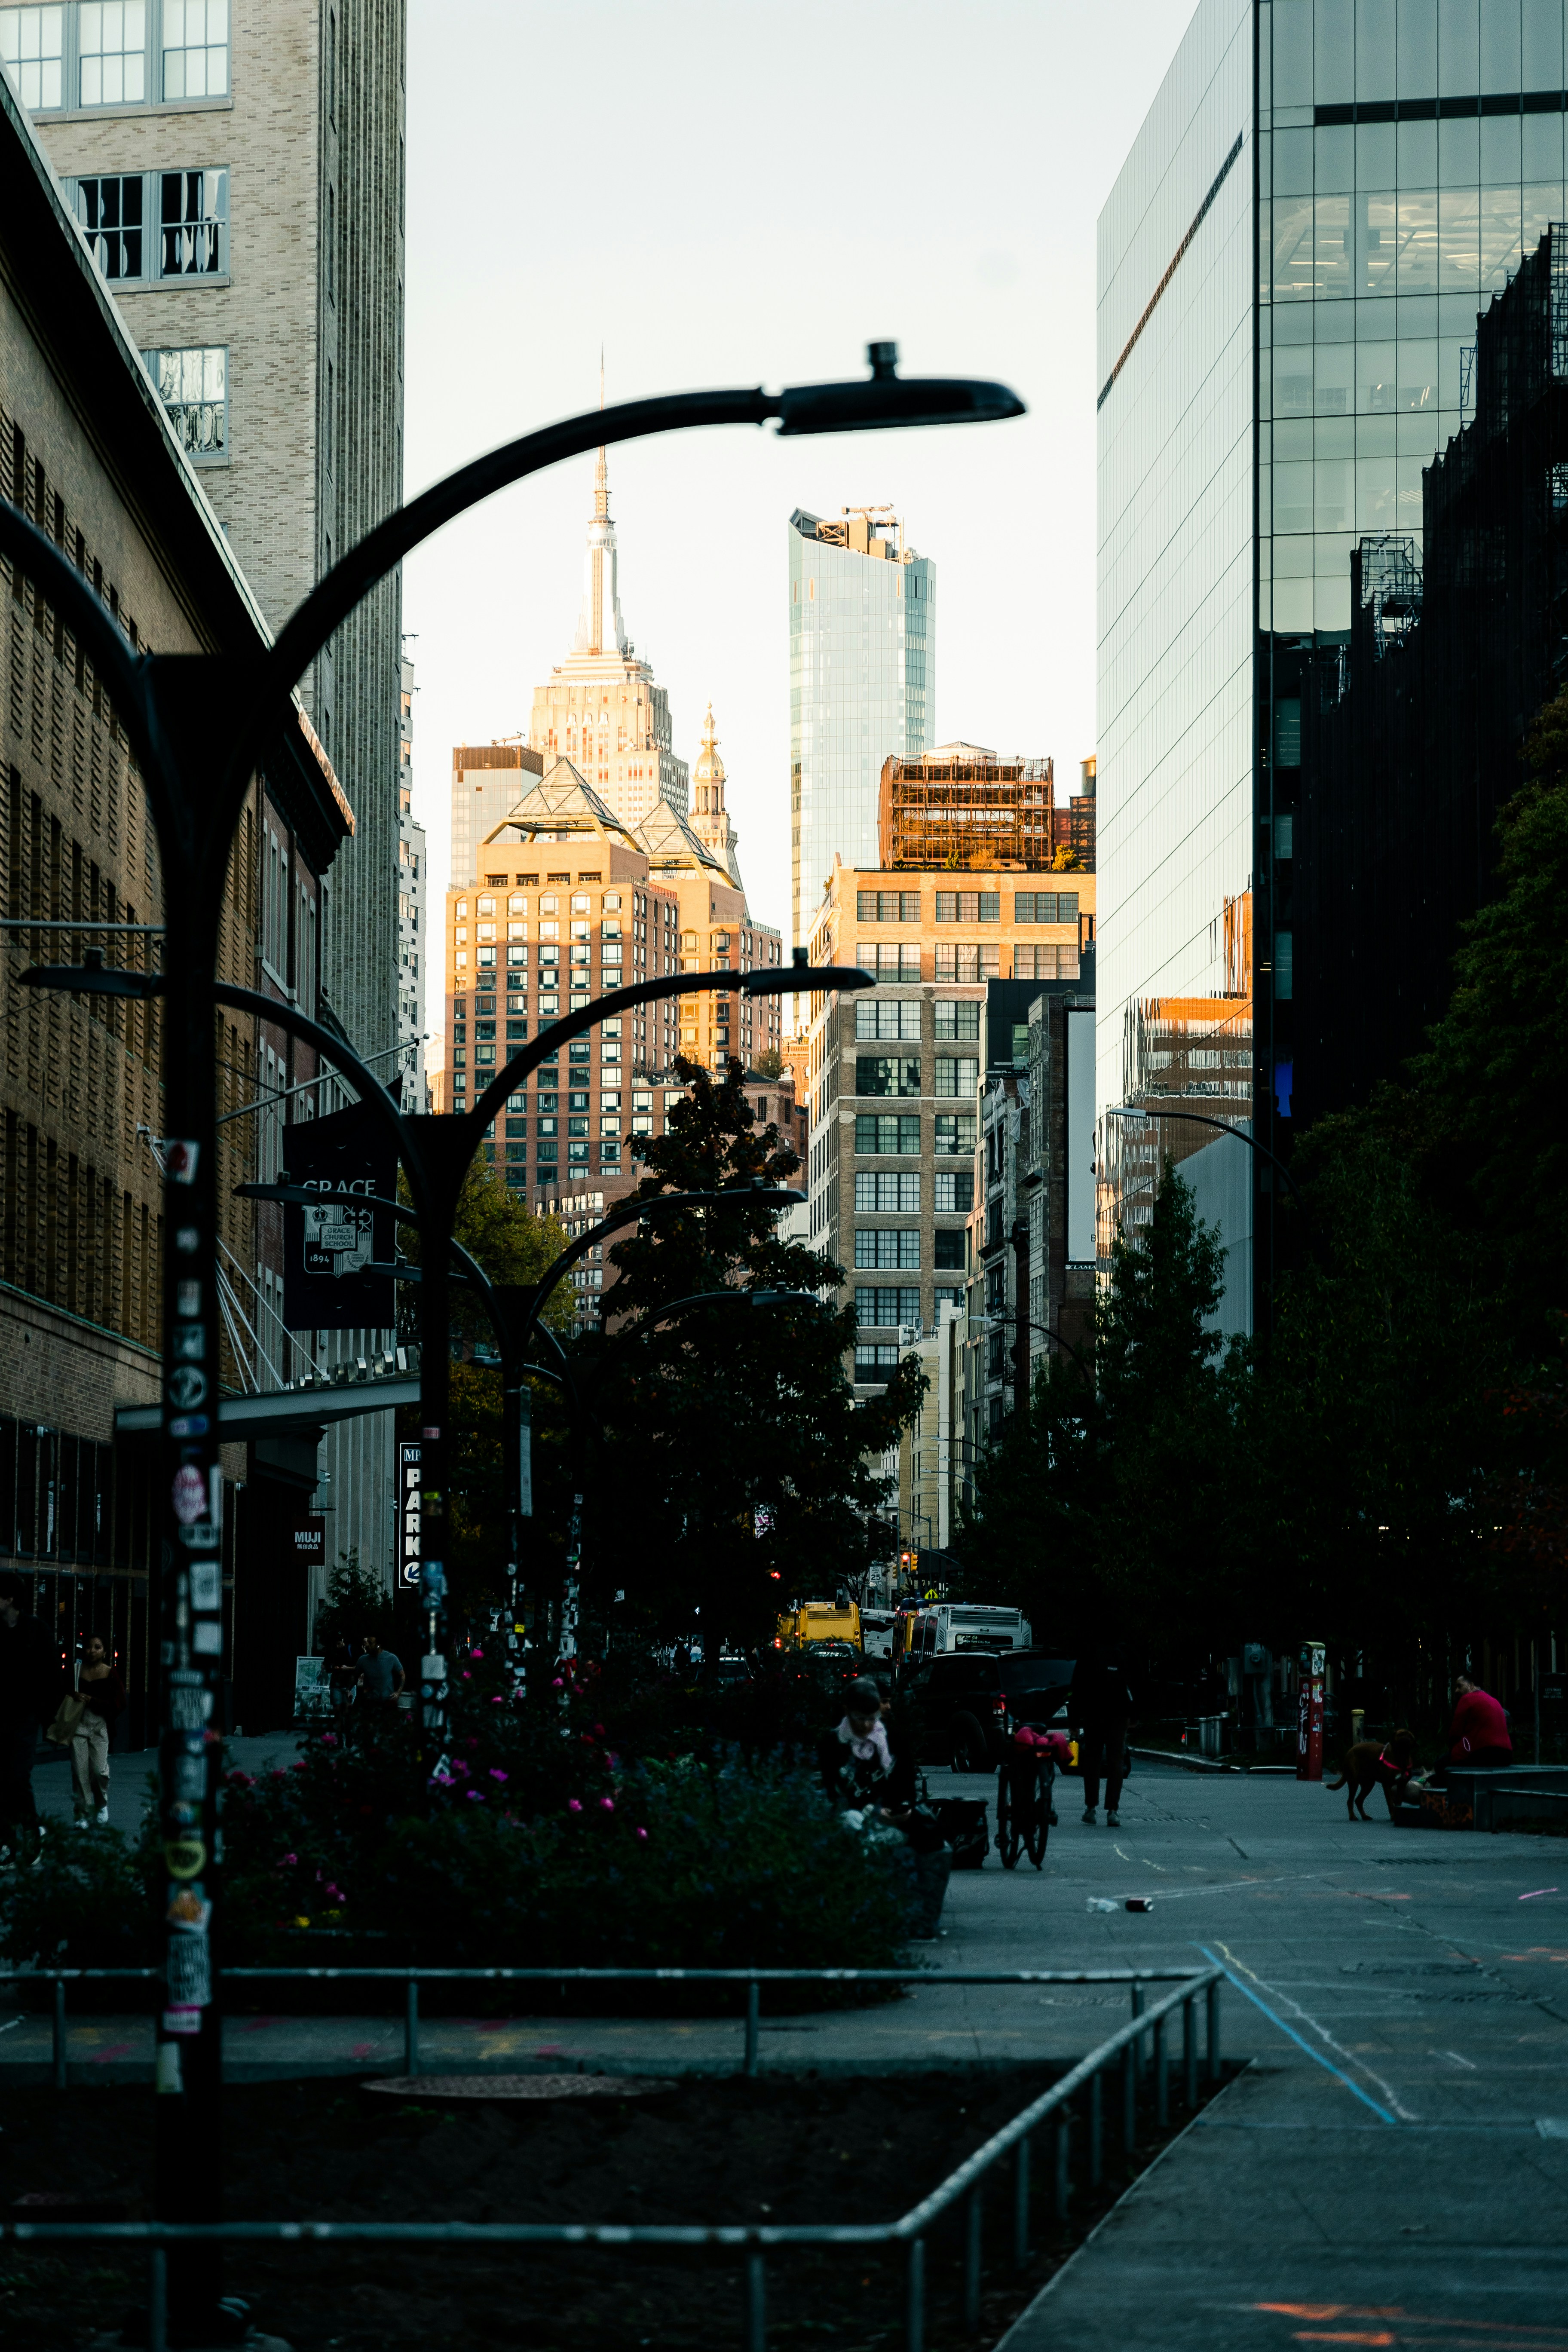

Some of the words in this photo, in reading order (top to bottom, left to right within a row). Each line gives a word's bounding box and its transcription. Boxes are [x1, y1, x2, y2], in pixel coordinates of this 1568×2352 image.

[310, 1254, 330, 1263] 1894
[405, 1468, 422, 1556] PARK
[295, 1532, 321, 1543] MUJI
